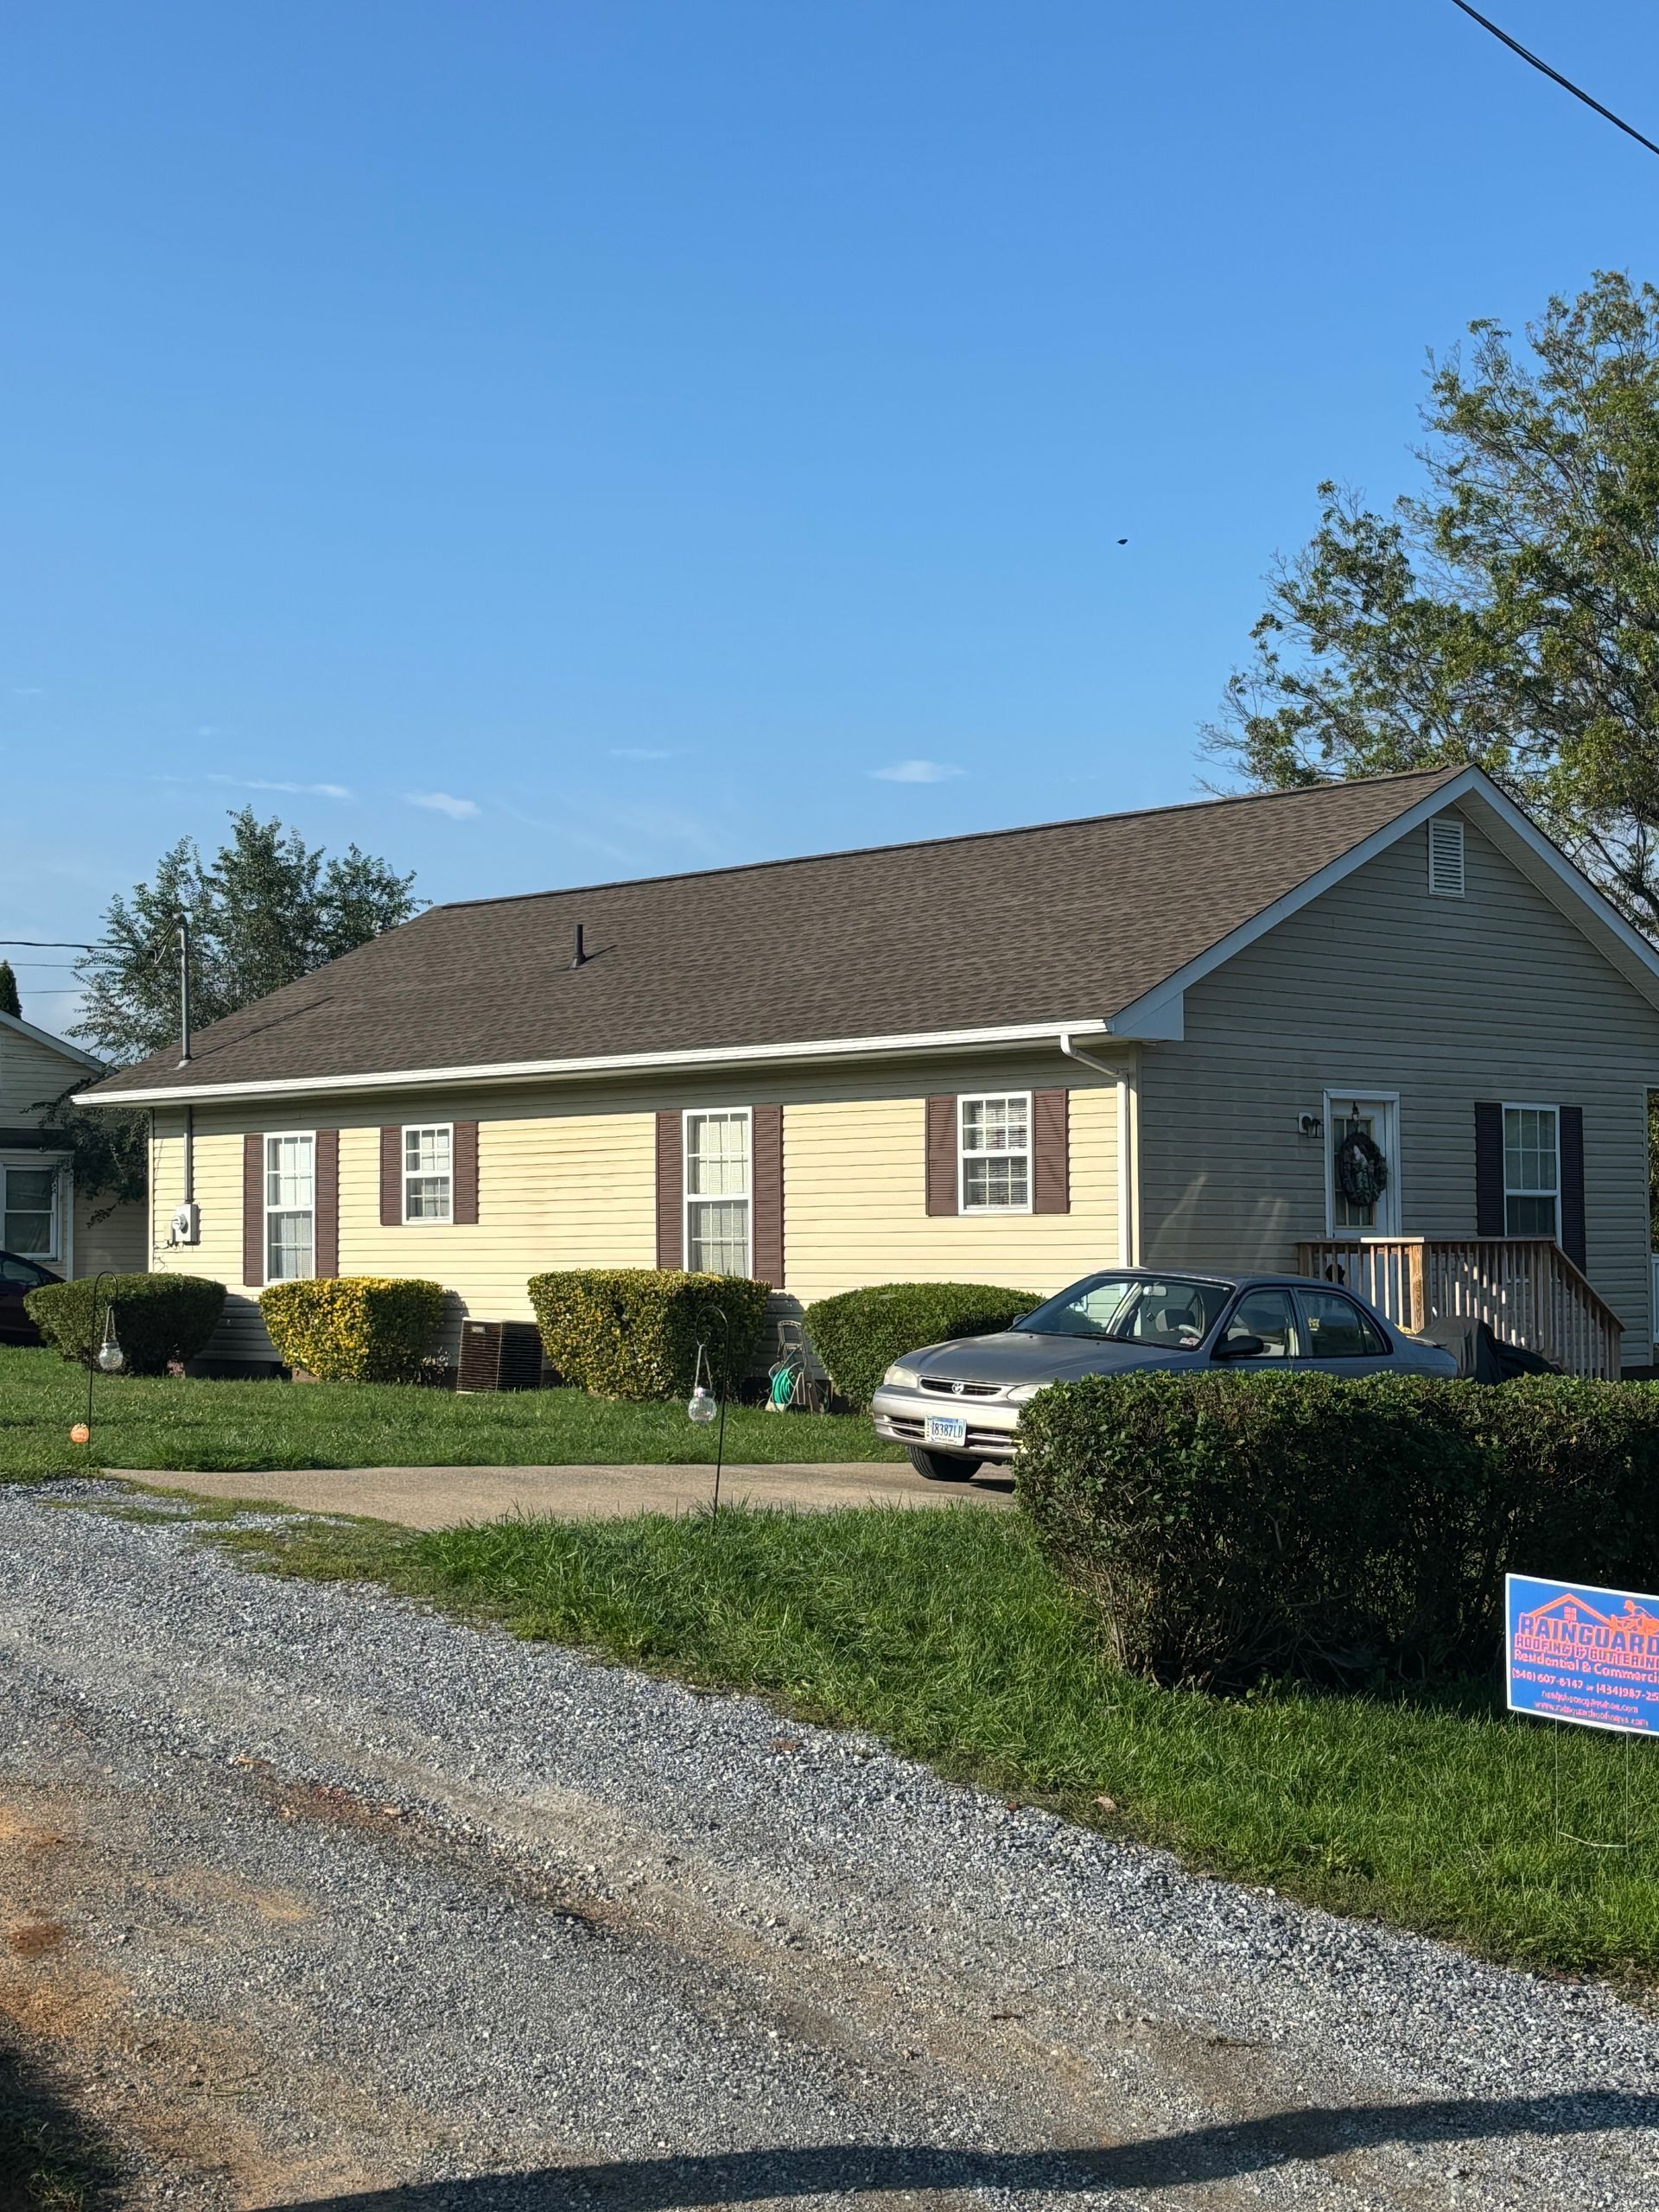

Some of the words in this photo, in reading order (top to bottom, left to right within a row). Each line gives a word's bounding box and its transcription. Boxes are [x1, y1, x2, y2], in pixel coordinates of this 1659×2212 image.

[1515, 1633, 1572, 1657] ROOFING
[1574, 1644, 1586, 1659] &
[1588, 1646, 1659, 1671] GUTTERIN
[1520, 1613, 1659, 1657] RAINGUARD
[1514, 1649, 1580, 1671] Residential
[1582, 1661, 1591, 1673] &
[1594, 1662, 1659, 1684] Commerci
